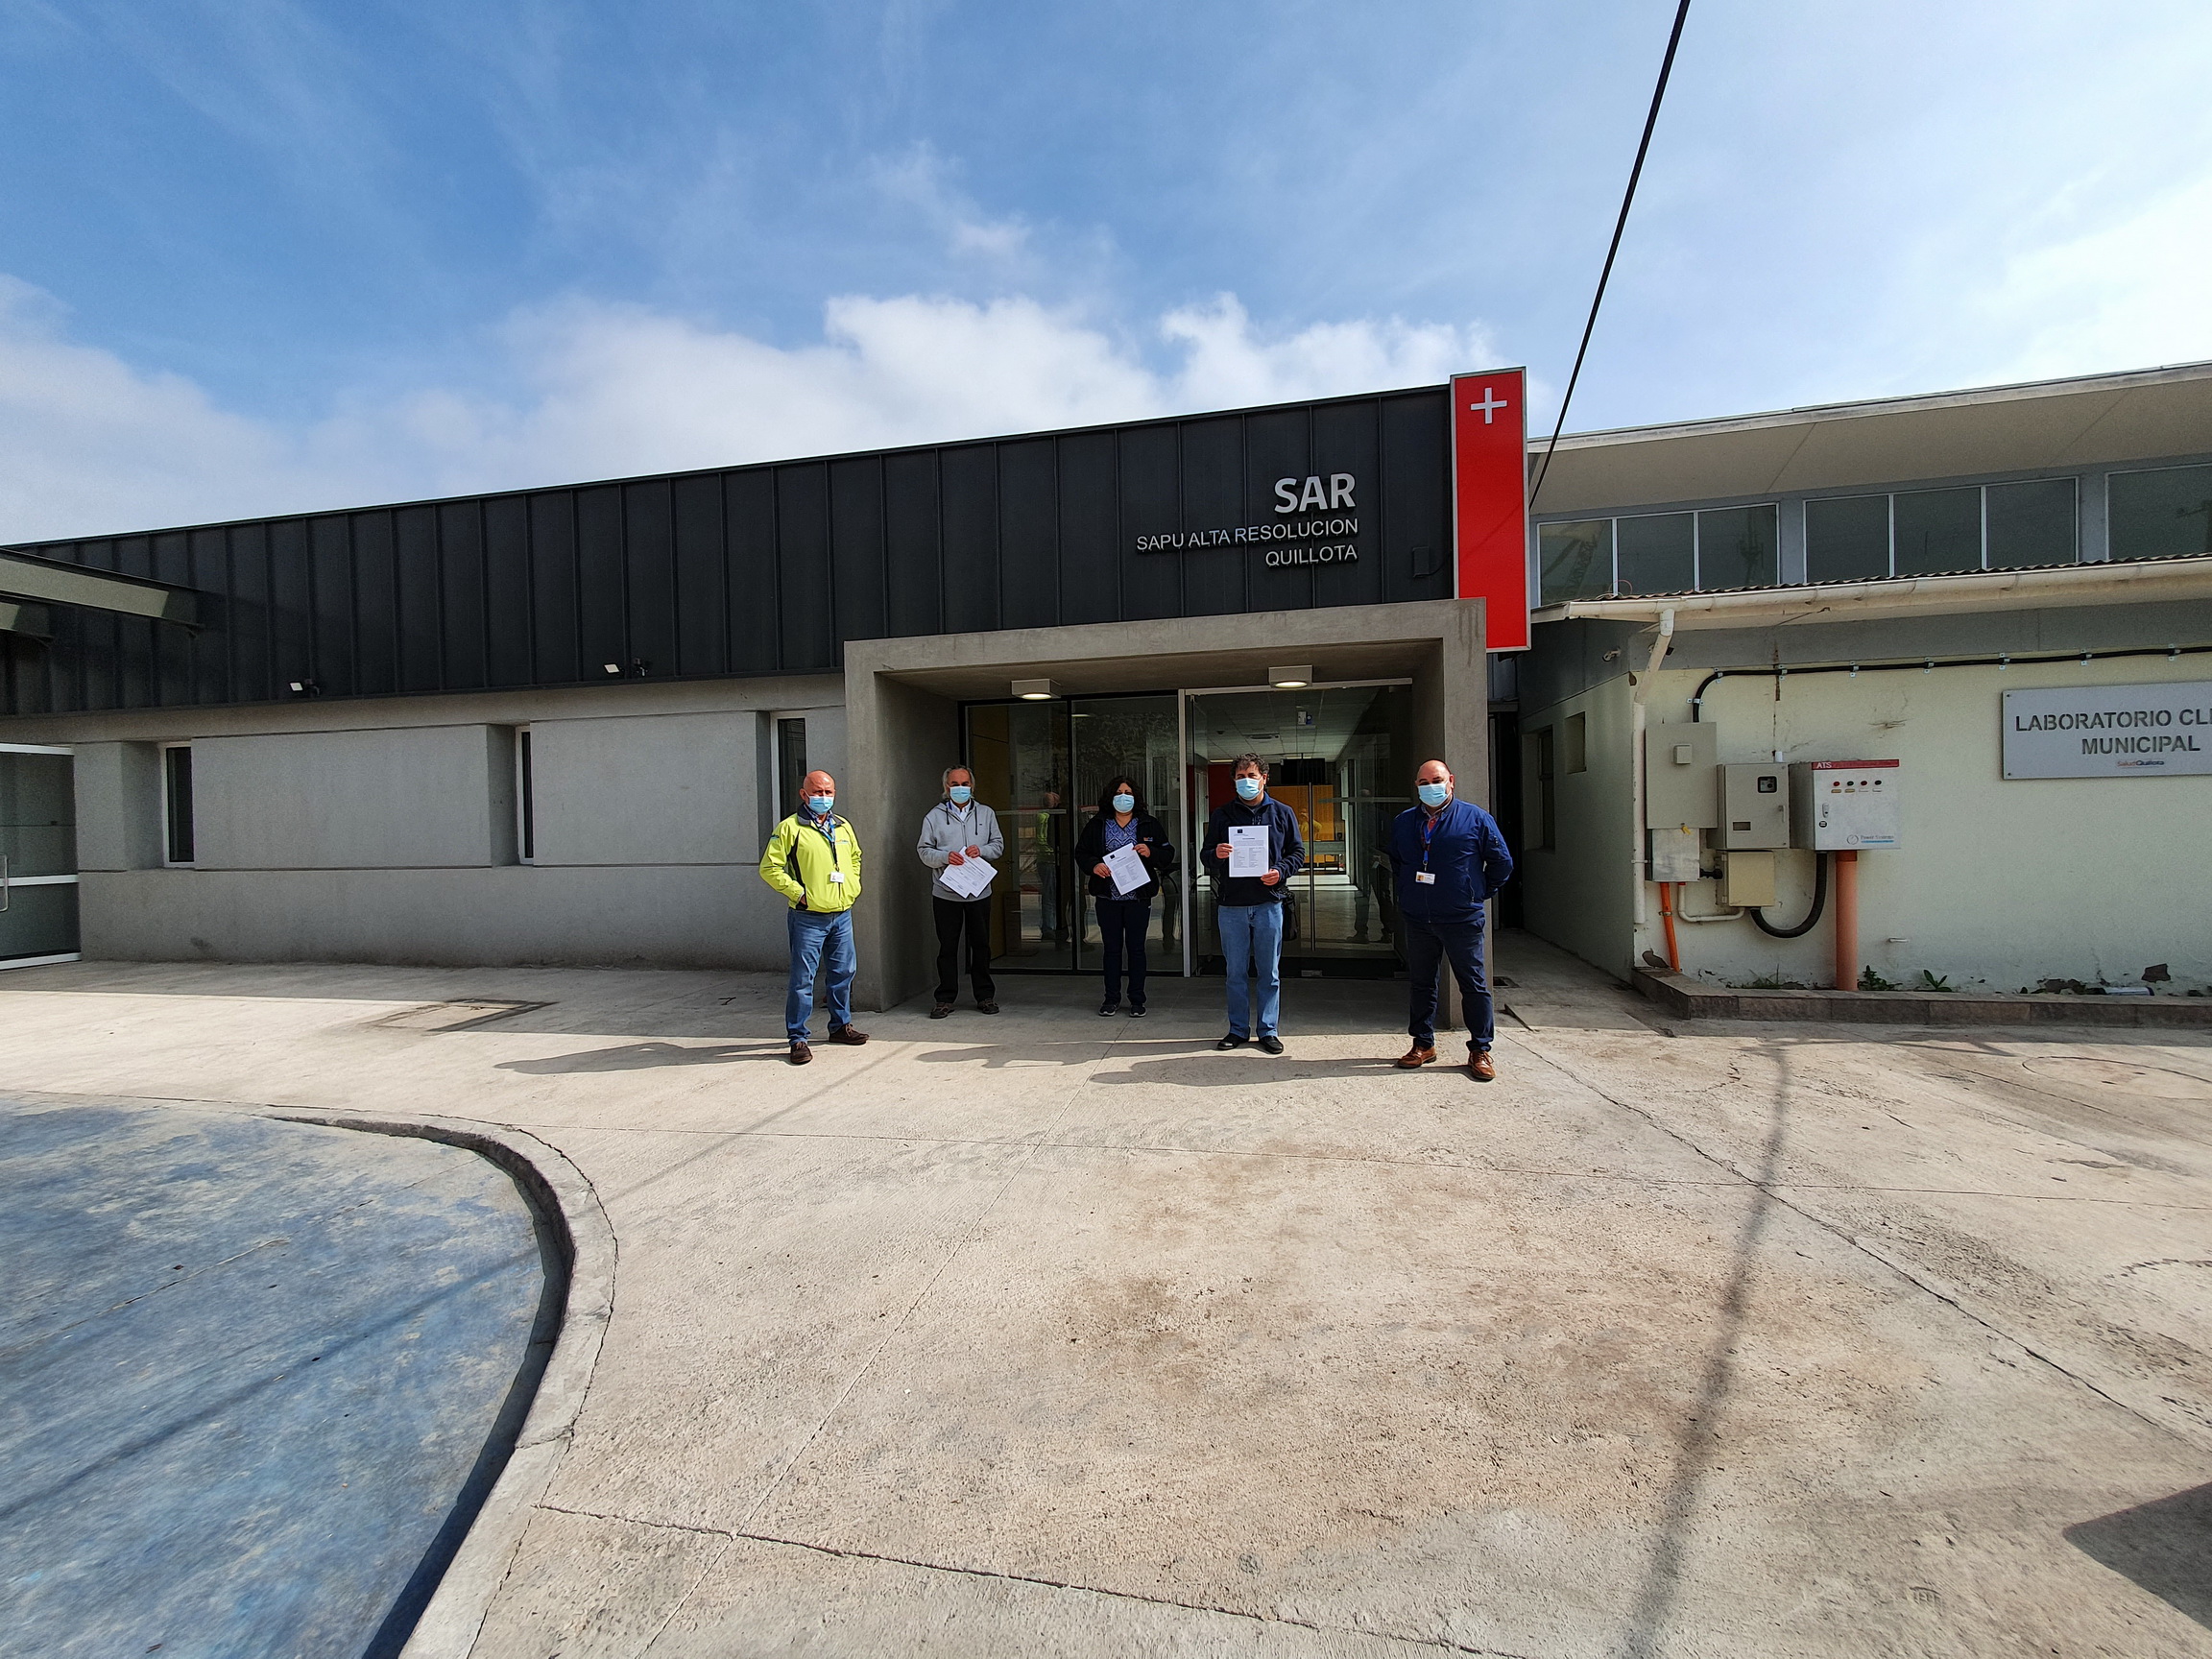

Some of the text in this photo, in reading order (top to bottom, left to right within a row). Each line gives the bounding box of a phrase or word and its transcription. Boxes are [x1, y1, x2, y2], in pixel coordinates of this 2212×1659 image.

[1274, 472, 1357, 514] SAR
[1136, 517, 1358, 551] SAPU ALTA RESOLUCION
[1264, 543, 1358, 567] QUILLOTA
[2015, 709, 2173, 732] LABORATORIO
[2081, 734, 2201, 755] MUNICIPAL
